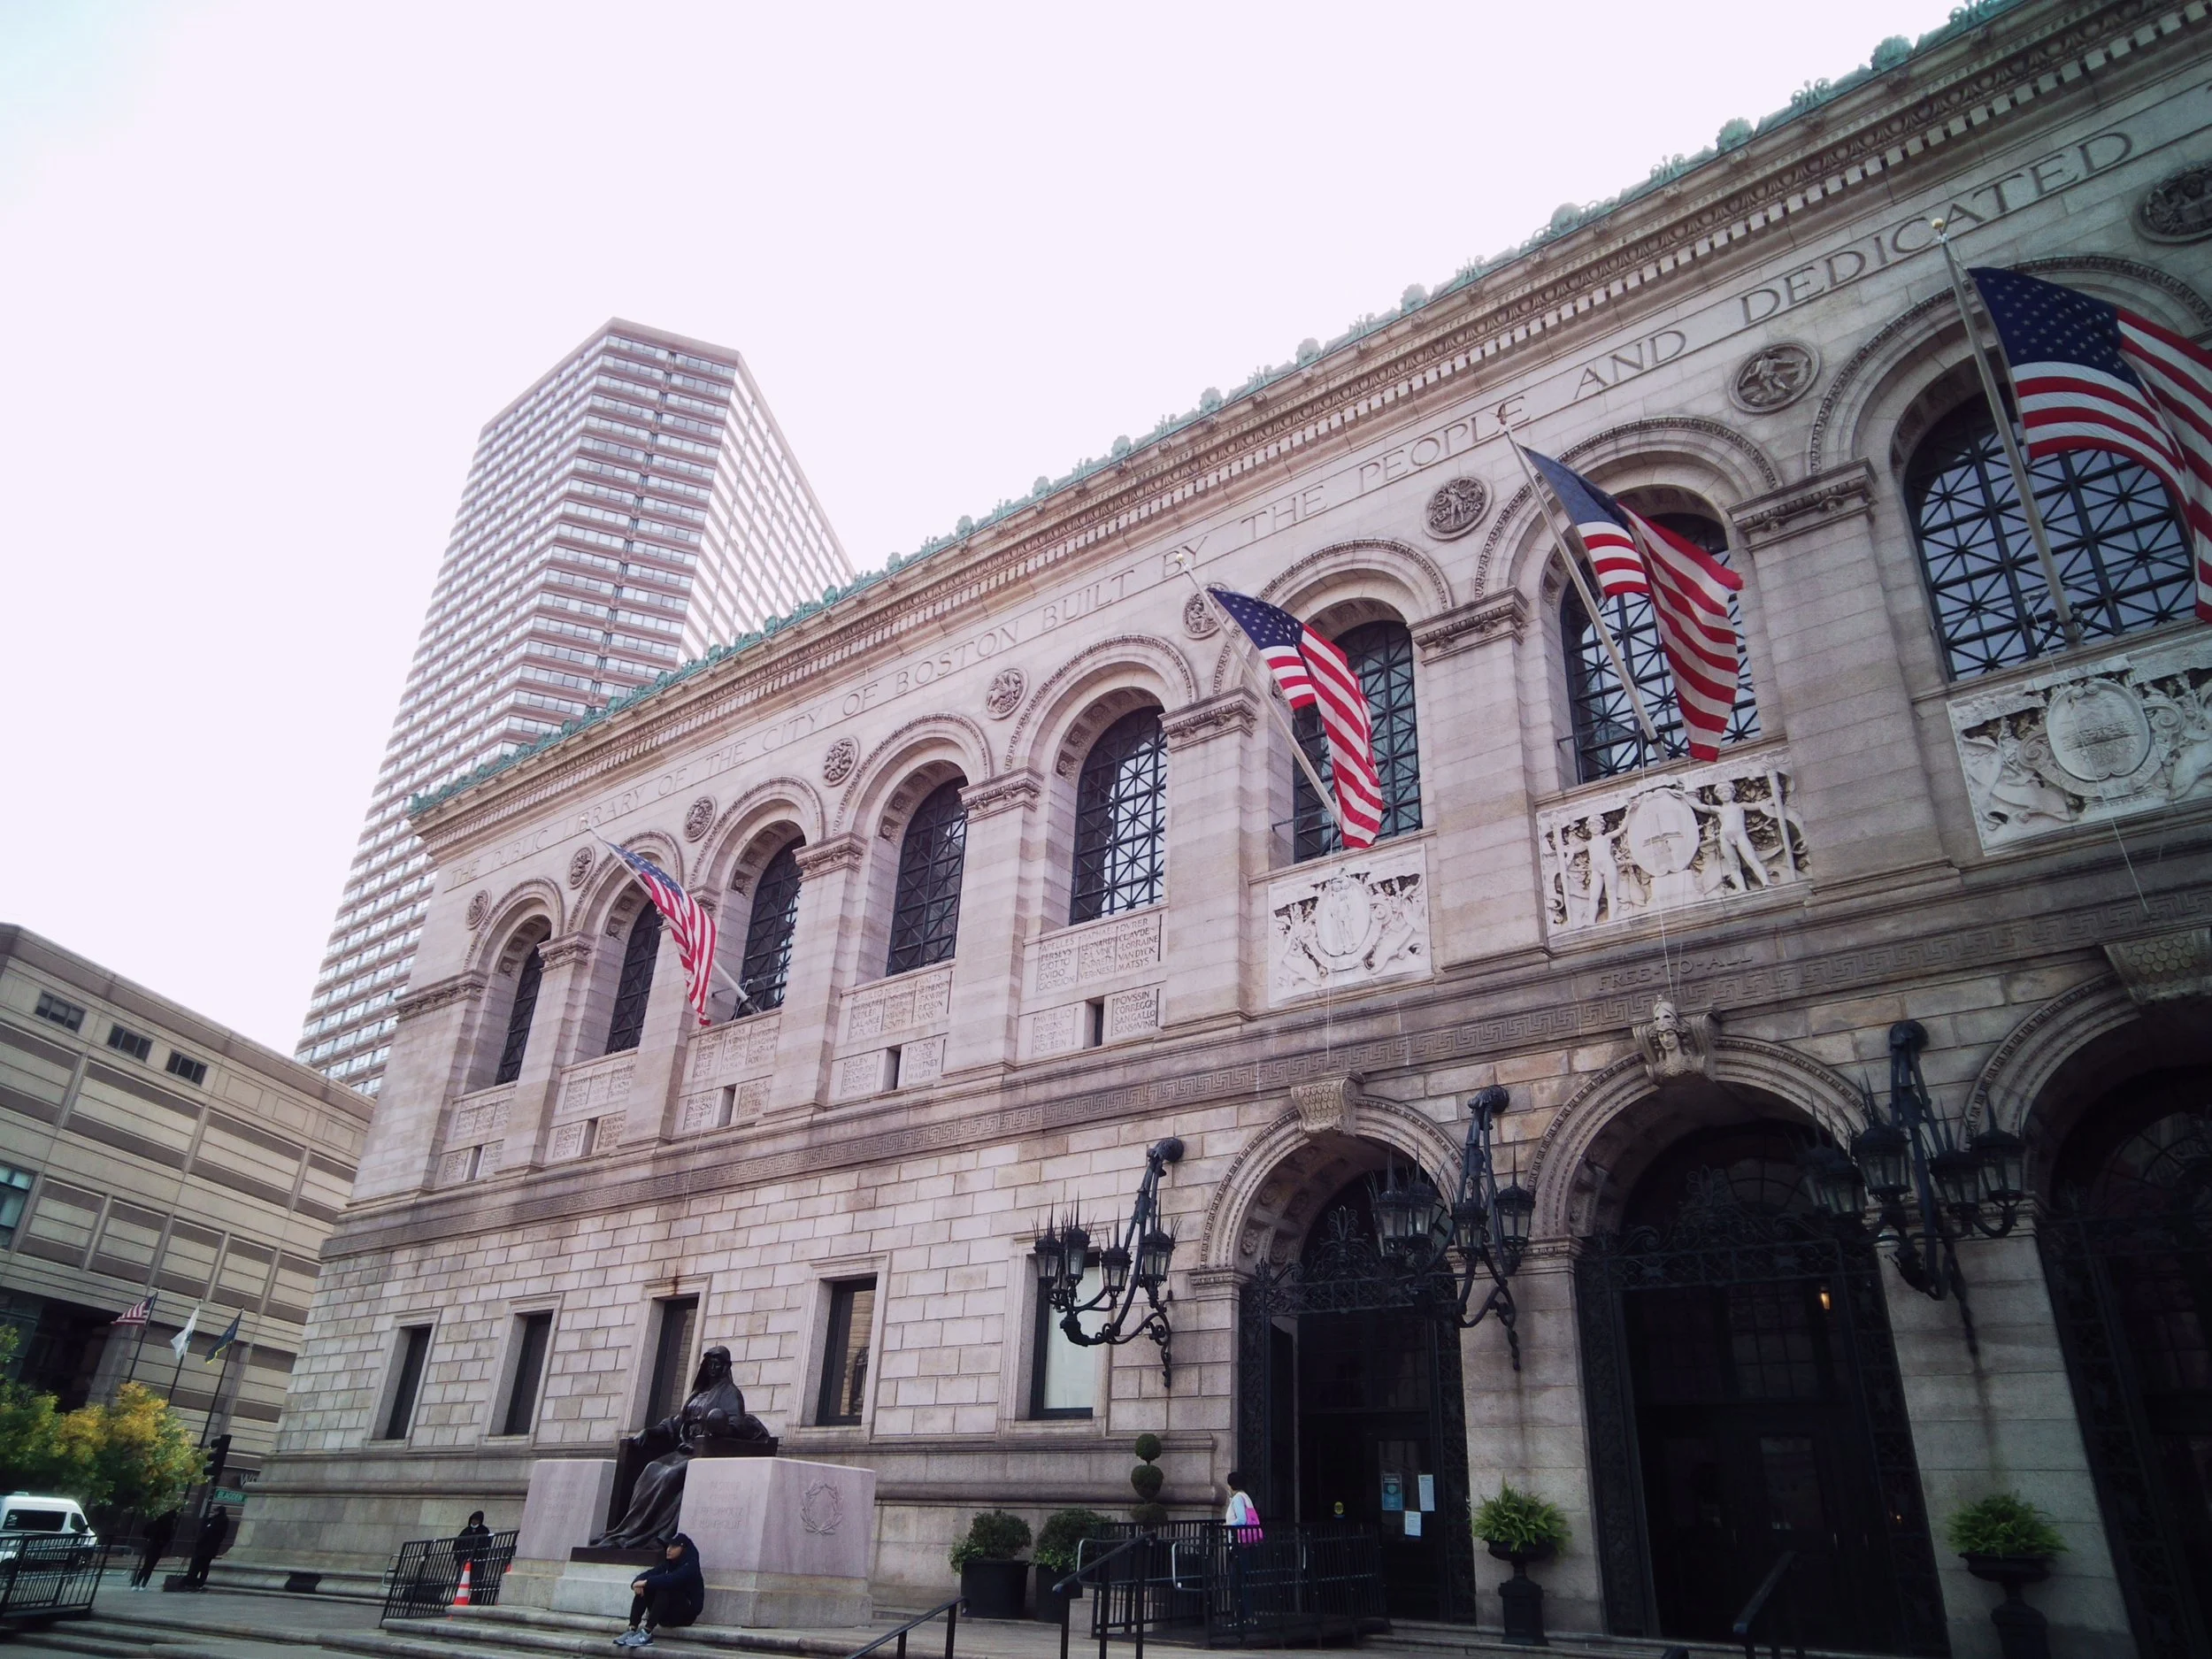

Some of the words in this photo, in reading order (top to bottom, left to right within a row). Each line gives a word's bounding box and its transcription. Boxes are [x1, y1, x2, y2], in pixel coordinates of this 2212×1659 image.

[451, 858, 481, 886] THE
[491, 829, 548, 868] PUBLIC
[562, 784, 645, 837] LIBRARY
[657, 767, 687, 797] OF
[706, 741, 747, 775] THE
[762, 708, 822, 751] CITY
[842, 683, 879, 717] OF
[895, 620, 1019, 695] BOSTON
[1041, 569, 1135, 632] BUILT
[1163, 535, 1209, 578] BY
[1240, 485, 1328, 539] THE
[1358, 395, 1532, 493] PEOPLE
[1574, 329, 1686, 399] AND
[1740, 130, 2134, 326] DEDICATED
